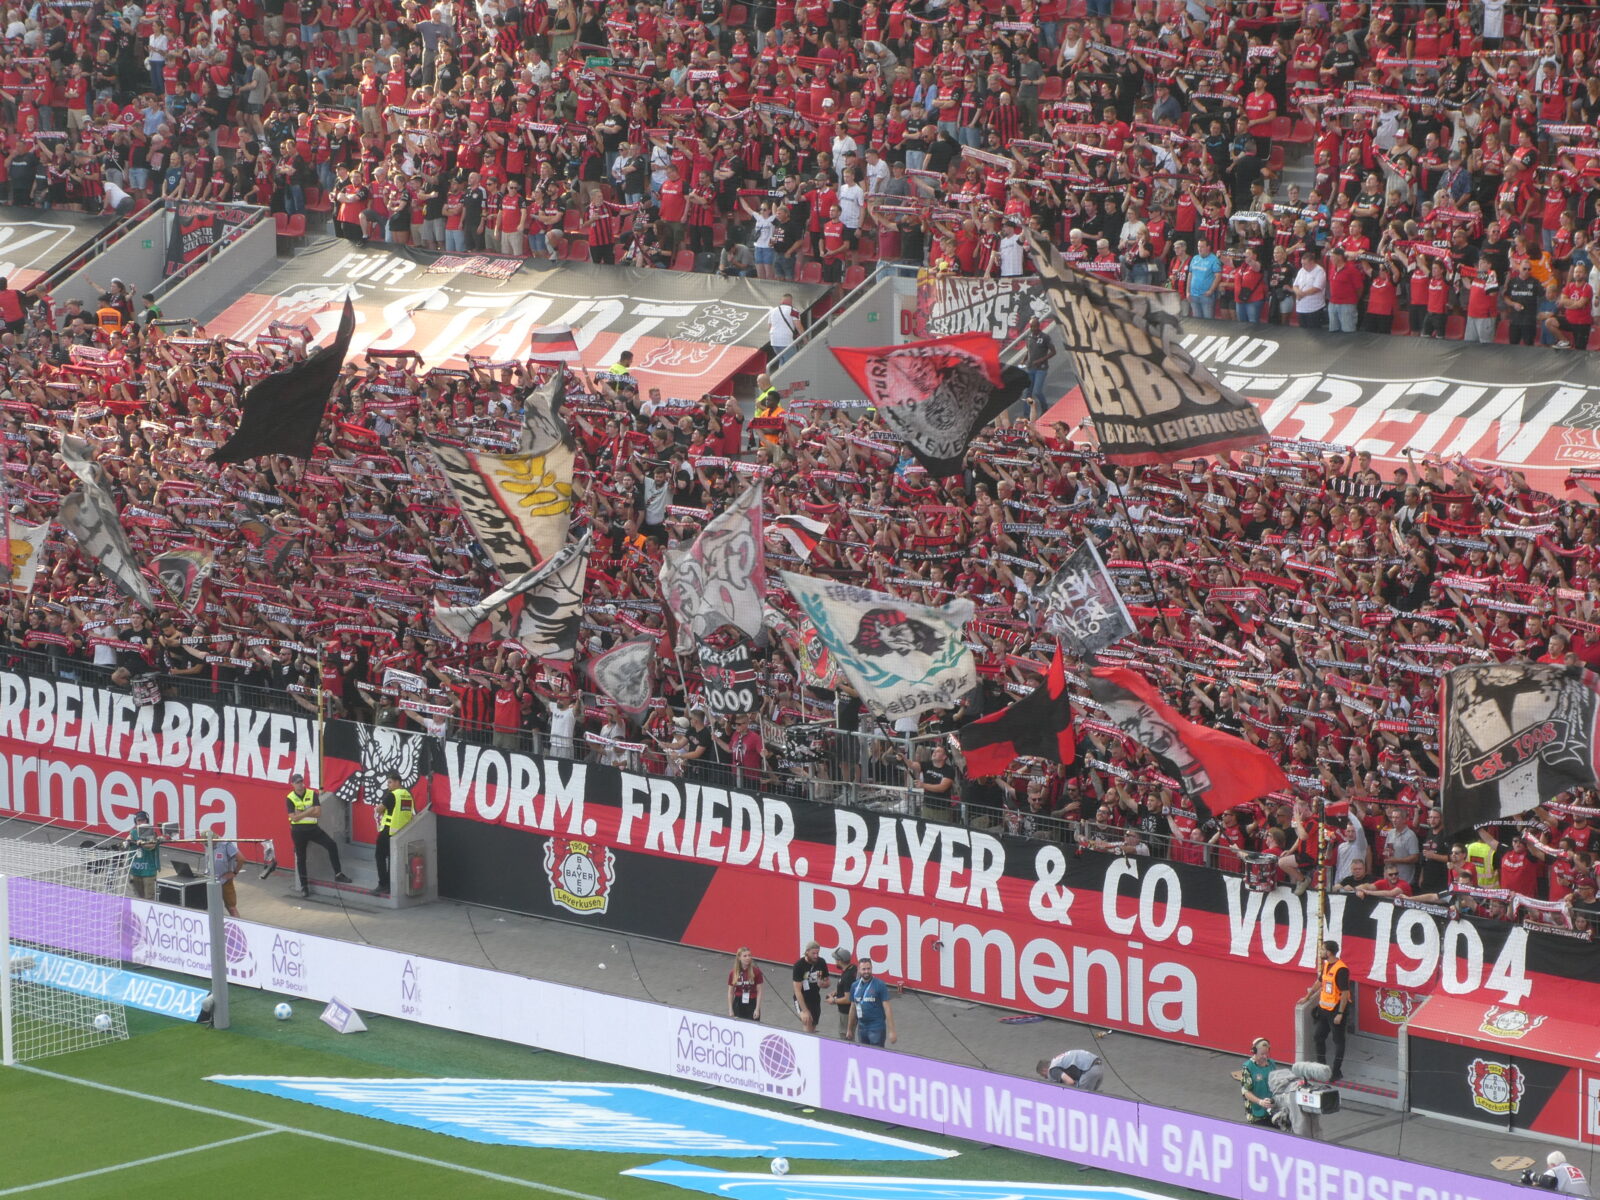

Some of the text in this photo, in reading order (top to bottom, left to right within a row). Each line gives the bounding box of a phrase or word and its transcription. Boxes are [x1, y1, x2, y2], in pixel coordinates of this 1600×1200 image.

[323, 252, 417, 285] FÜR
[364, 290, 698, 367] STADT
[1179, 334, 1280, 368] UND
[0, 671, 324, 789] RBENFABRIKEN
[1471, 722, 1558, 781] est. 1998
[0, 751, 238, 841] rmenia
[445, 740, 1533, 1005] VORM. FRIEDR. BAYER & CO. VON 1904
[566, 869, 593, 880] BAYER
[557, 890, 602, 908] Leverkusen
[145, 905, 204, 936] Archon
[799, 880, 1200, 1037] Barmenia
[122, 977, 205, 1017] NIEDAX
[677, 1015, 744, 1048] Archon
[677, 1037, 756, 1074] Meridian
[676, 1063, 765, 1092] SAP Security Consulting
[1484, 1083, 1506, 1092] BAYER
[843, 1057, 973, 1129] ARCHON
[984, 1086, 1149, 1168] MERIDIAN
[1162, 1123, 1234, 1183] SAP
